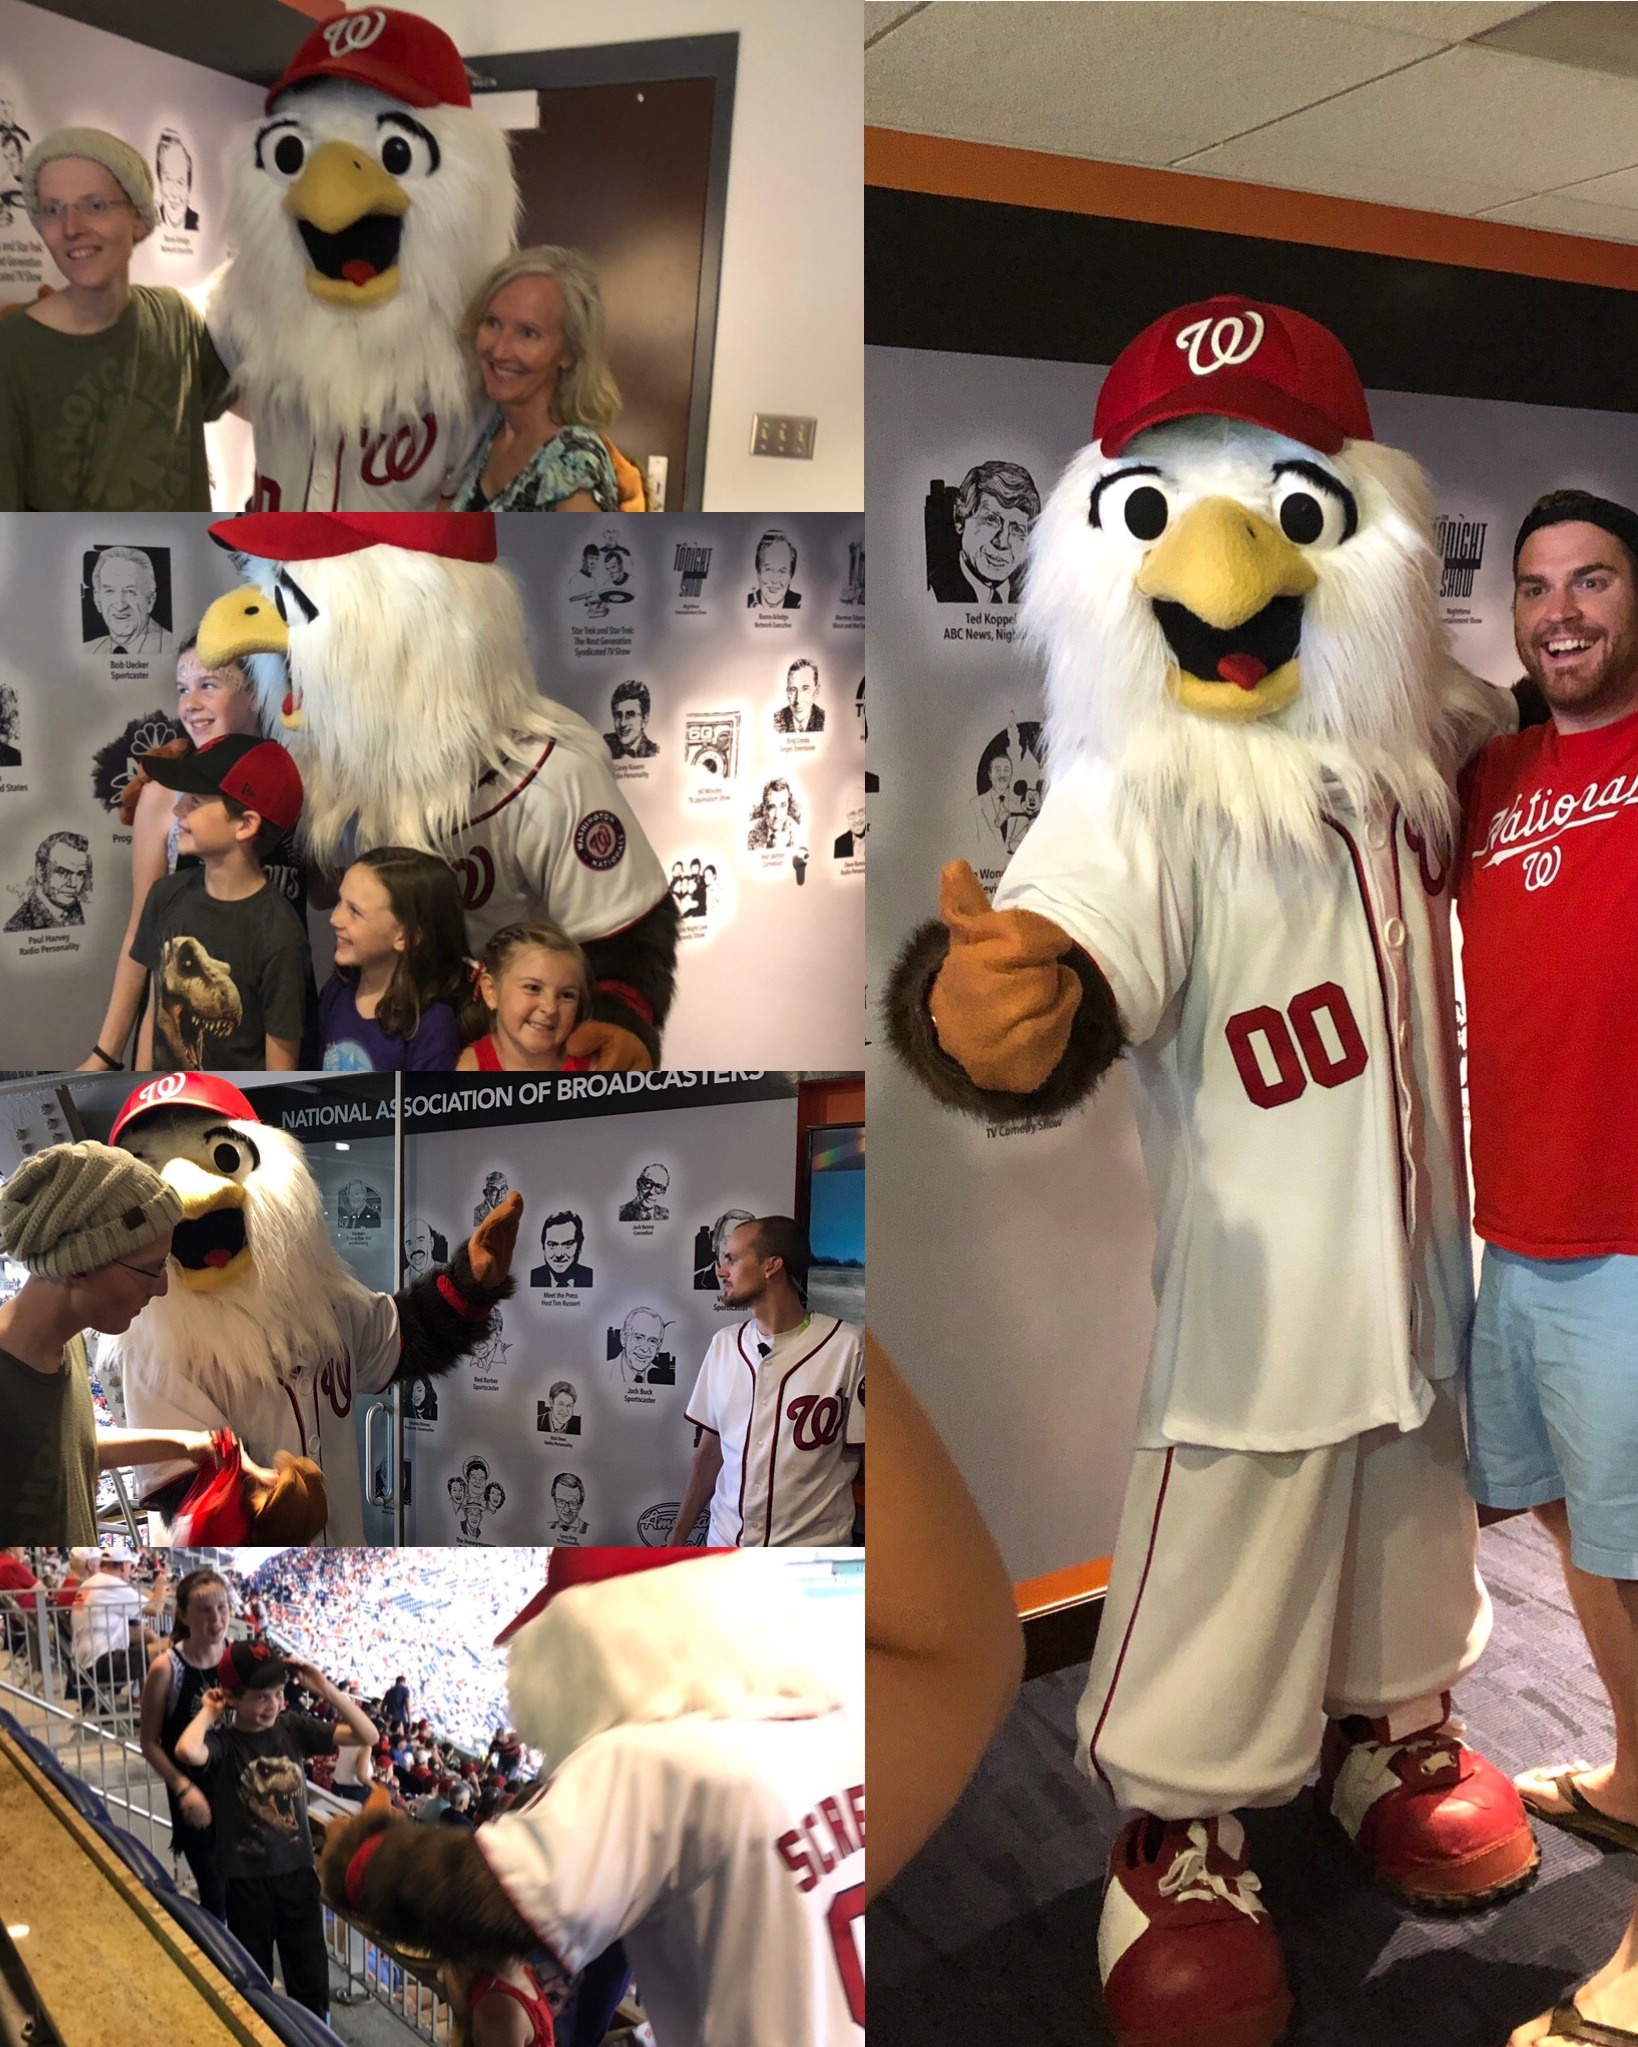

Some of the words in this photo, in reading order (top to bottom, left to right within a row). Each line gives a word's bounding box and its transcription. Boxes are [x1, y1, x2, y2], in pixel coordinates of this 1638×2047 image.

[323, 11, 387, 57] W
[1176, 310, 1265, 375] W
[1433, 516, 1488, 560] ONIGHT
[1440, 568, 1475, 598] SHOW
[943, 628, 963, 640] ABC
[965, 628, 994, 641] News,
[965, 613, 982, 624] Ted
[984, 613, 1017, 627] Koppel
[110, 661, 124, 669] Bob
[126, 660, 149, 669] Uecker
[6, 784, 28, 792] States
[113, 834, 132, 845] Prog
[576, 812, 615, 851] WASHINGTON
[591, 833, 625, 868] NATIONALS
[1522, 845, 1562, 892] W
[19, 946, 40, 956] Radio
[41, 942, 80, 953] Personality
[28, 935, 44, 944] Paul
[45, 934, 70, 942] Harvey
[1225, 981, 1369, 1110] 00
[282, 1102, 372, 1129] NATIONAL
[375, 1085, 513, 1120] ASSOCIATION
[518, 1081, 551, 1105] OF
[986, 1128, 998, 1138] TV
[999, 1121, 1035, 1136] Comedy
[786, 1388, 844, 1451] W
[776, 1784, 865, 1893] SCRE
